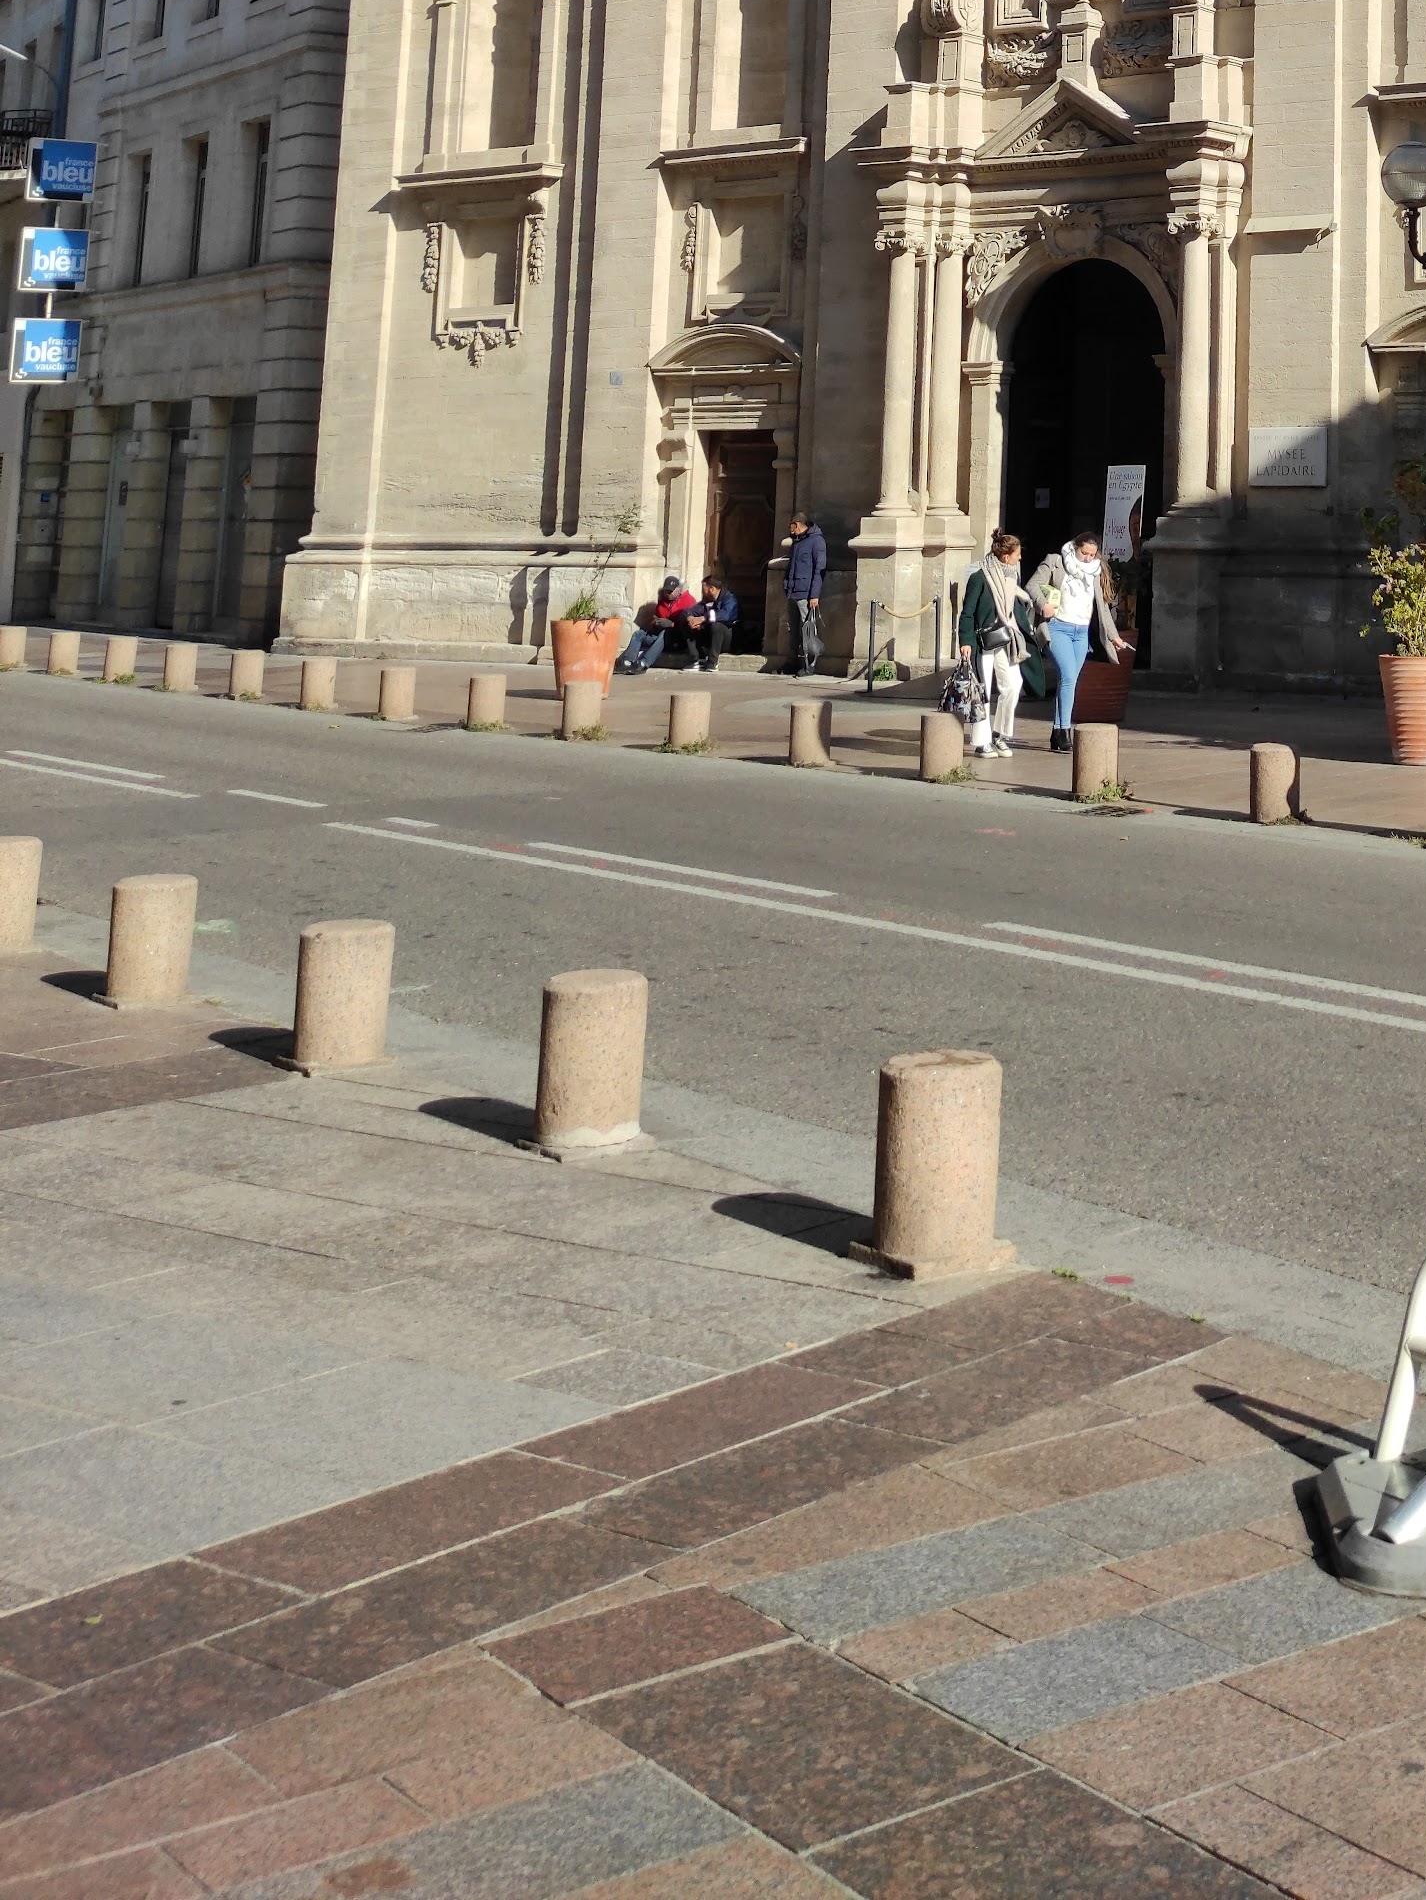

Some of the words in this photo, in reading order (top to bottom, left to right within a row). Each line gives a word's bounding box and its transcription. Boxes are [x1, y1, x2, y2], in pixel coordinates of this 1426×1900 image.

[65, 157, 94, 167] france
[41, 160, 94, 184] bleu
[52, 183, 92, 191] vaucluse
[56, 245, 86, 255] france
[33, 249, 86, 272] bleu
[43, 271, 85, 280] vaucluse
[48, 336, 78, 346] france
[25, 340, 77, 363] bleu
[35, 363, 76, 371] vaucluse
[1123, 471, 1143, 480] saison
[1256, 465, 1316, 476] LAPIDAIRE
